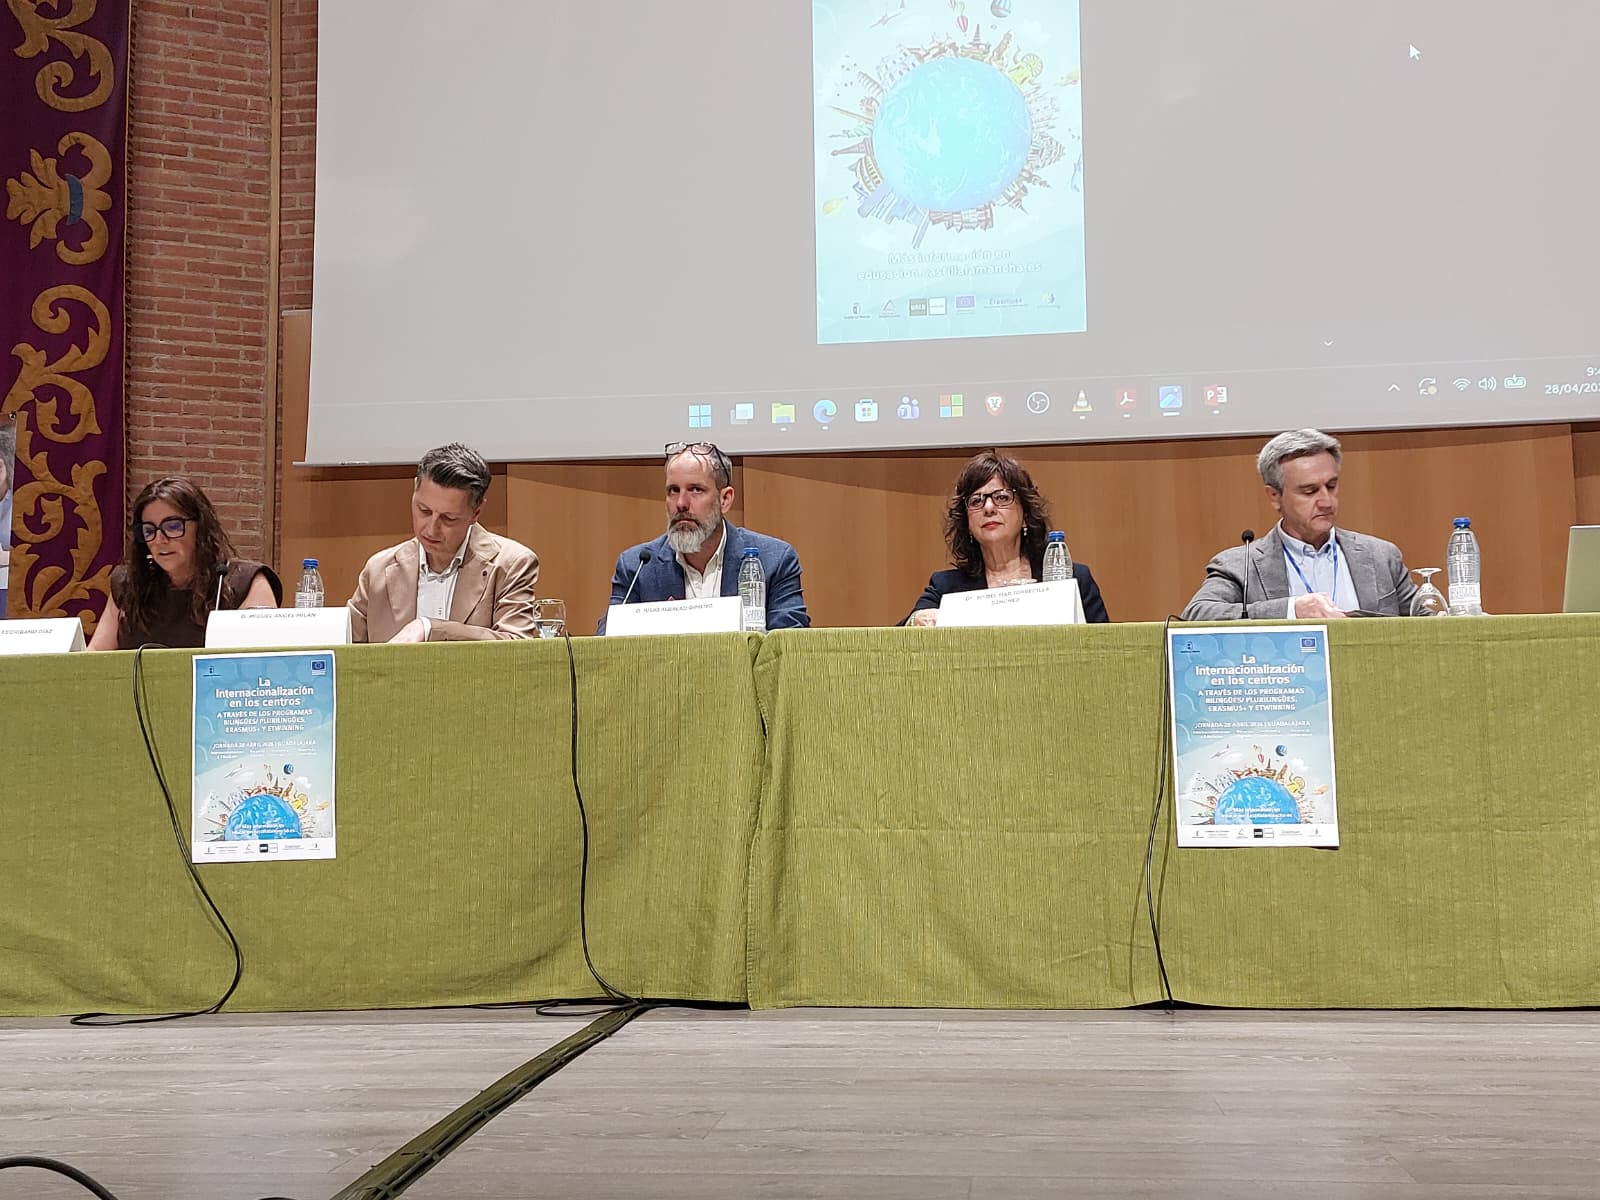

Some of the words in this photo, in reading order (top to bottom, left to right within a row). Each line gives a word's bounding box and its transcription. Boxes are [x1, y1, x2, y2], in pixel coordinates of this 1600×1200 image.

[1545, 382, 1600, 396] 28/04/20
[1242, 654, 1256, 664] La
[1195, 663, 1305, 676] Internacionalización
[259, 677, 271, 687] La
[1210, 677, 1225, 686] en
[1228, 675, 1244, 685] los
[1247, 674, 1290, 685] centros
[215, 686, 314, 699] Internacionalización
[1259, 687, 1305, 695] PROGRAMAS
[229, 700, 242, 708] en
[244, 698, 260, 707] los
[262, 696, 301, 707] centros
[272, 708, 313, 717] PROGRAMAS
